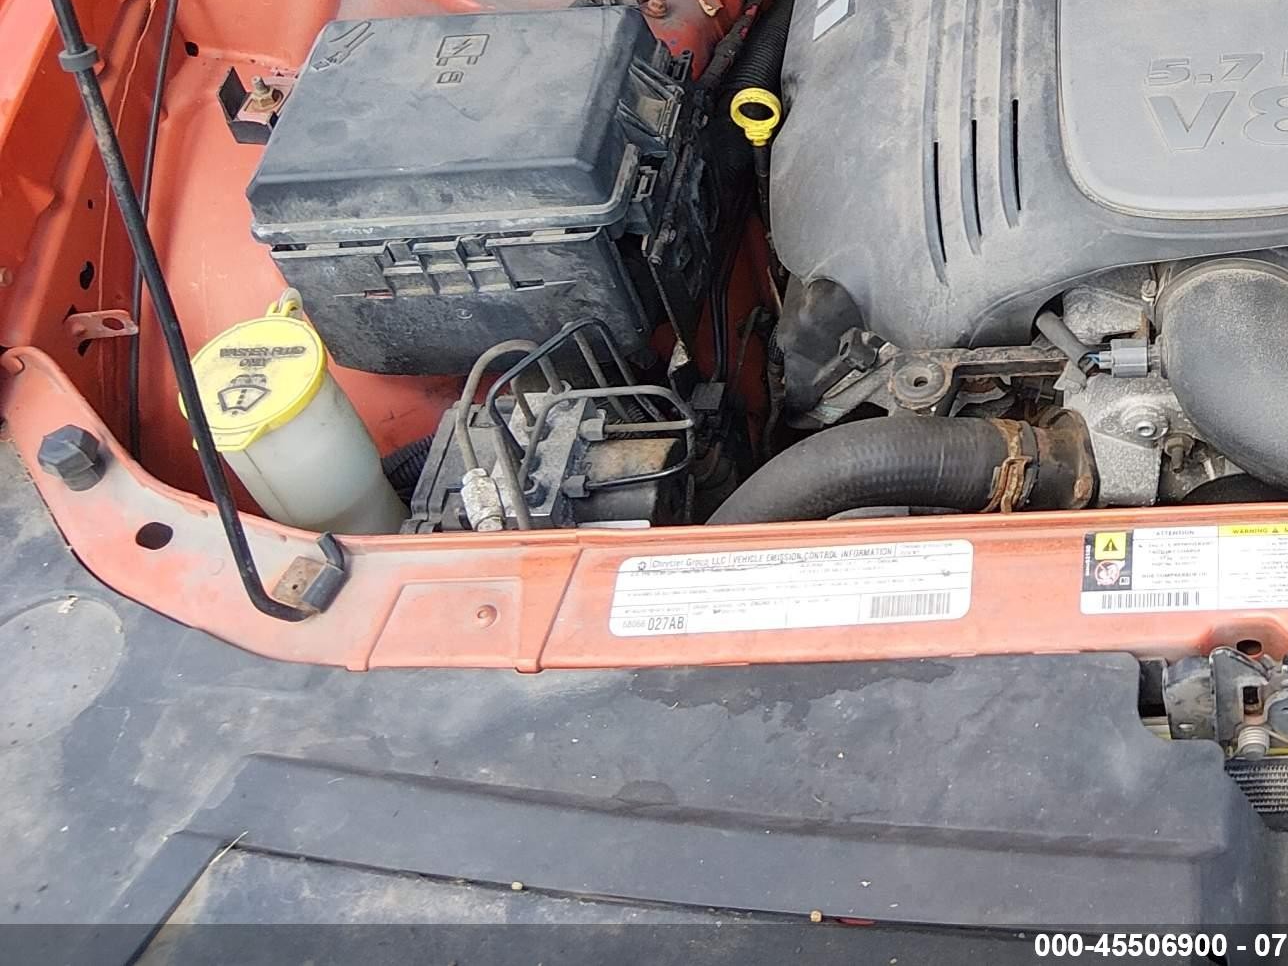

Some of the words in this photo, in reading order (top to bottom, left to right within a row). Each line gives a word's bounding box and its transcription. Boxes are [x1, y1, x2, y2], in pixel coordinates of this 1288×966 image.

[1232, 527, 1268, 535] WARNING
[711, 555, 727, 565] LLC
[733, 553, 763, 564] VEHICLE
[766, 551, 802, 563] EMISSION
[804, 550, 838, 562] CONTROL
[841, 547, 893, 559] INFORMATION
[647, 616, 685, 631] 027AB
